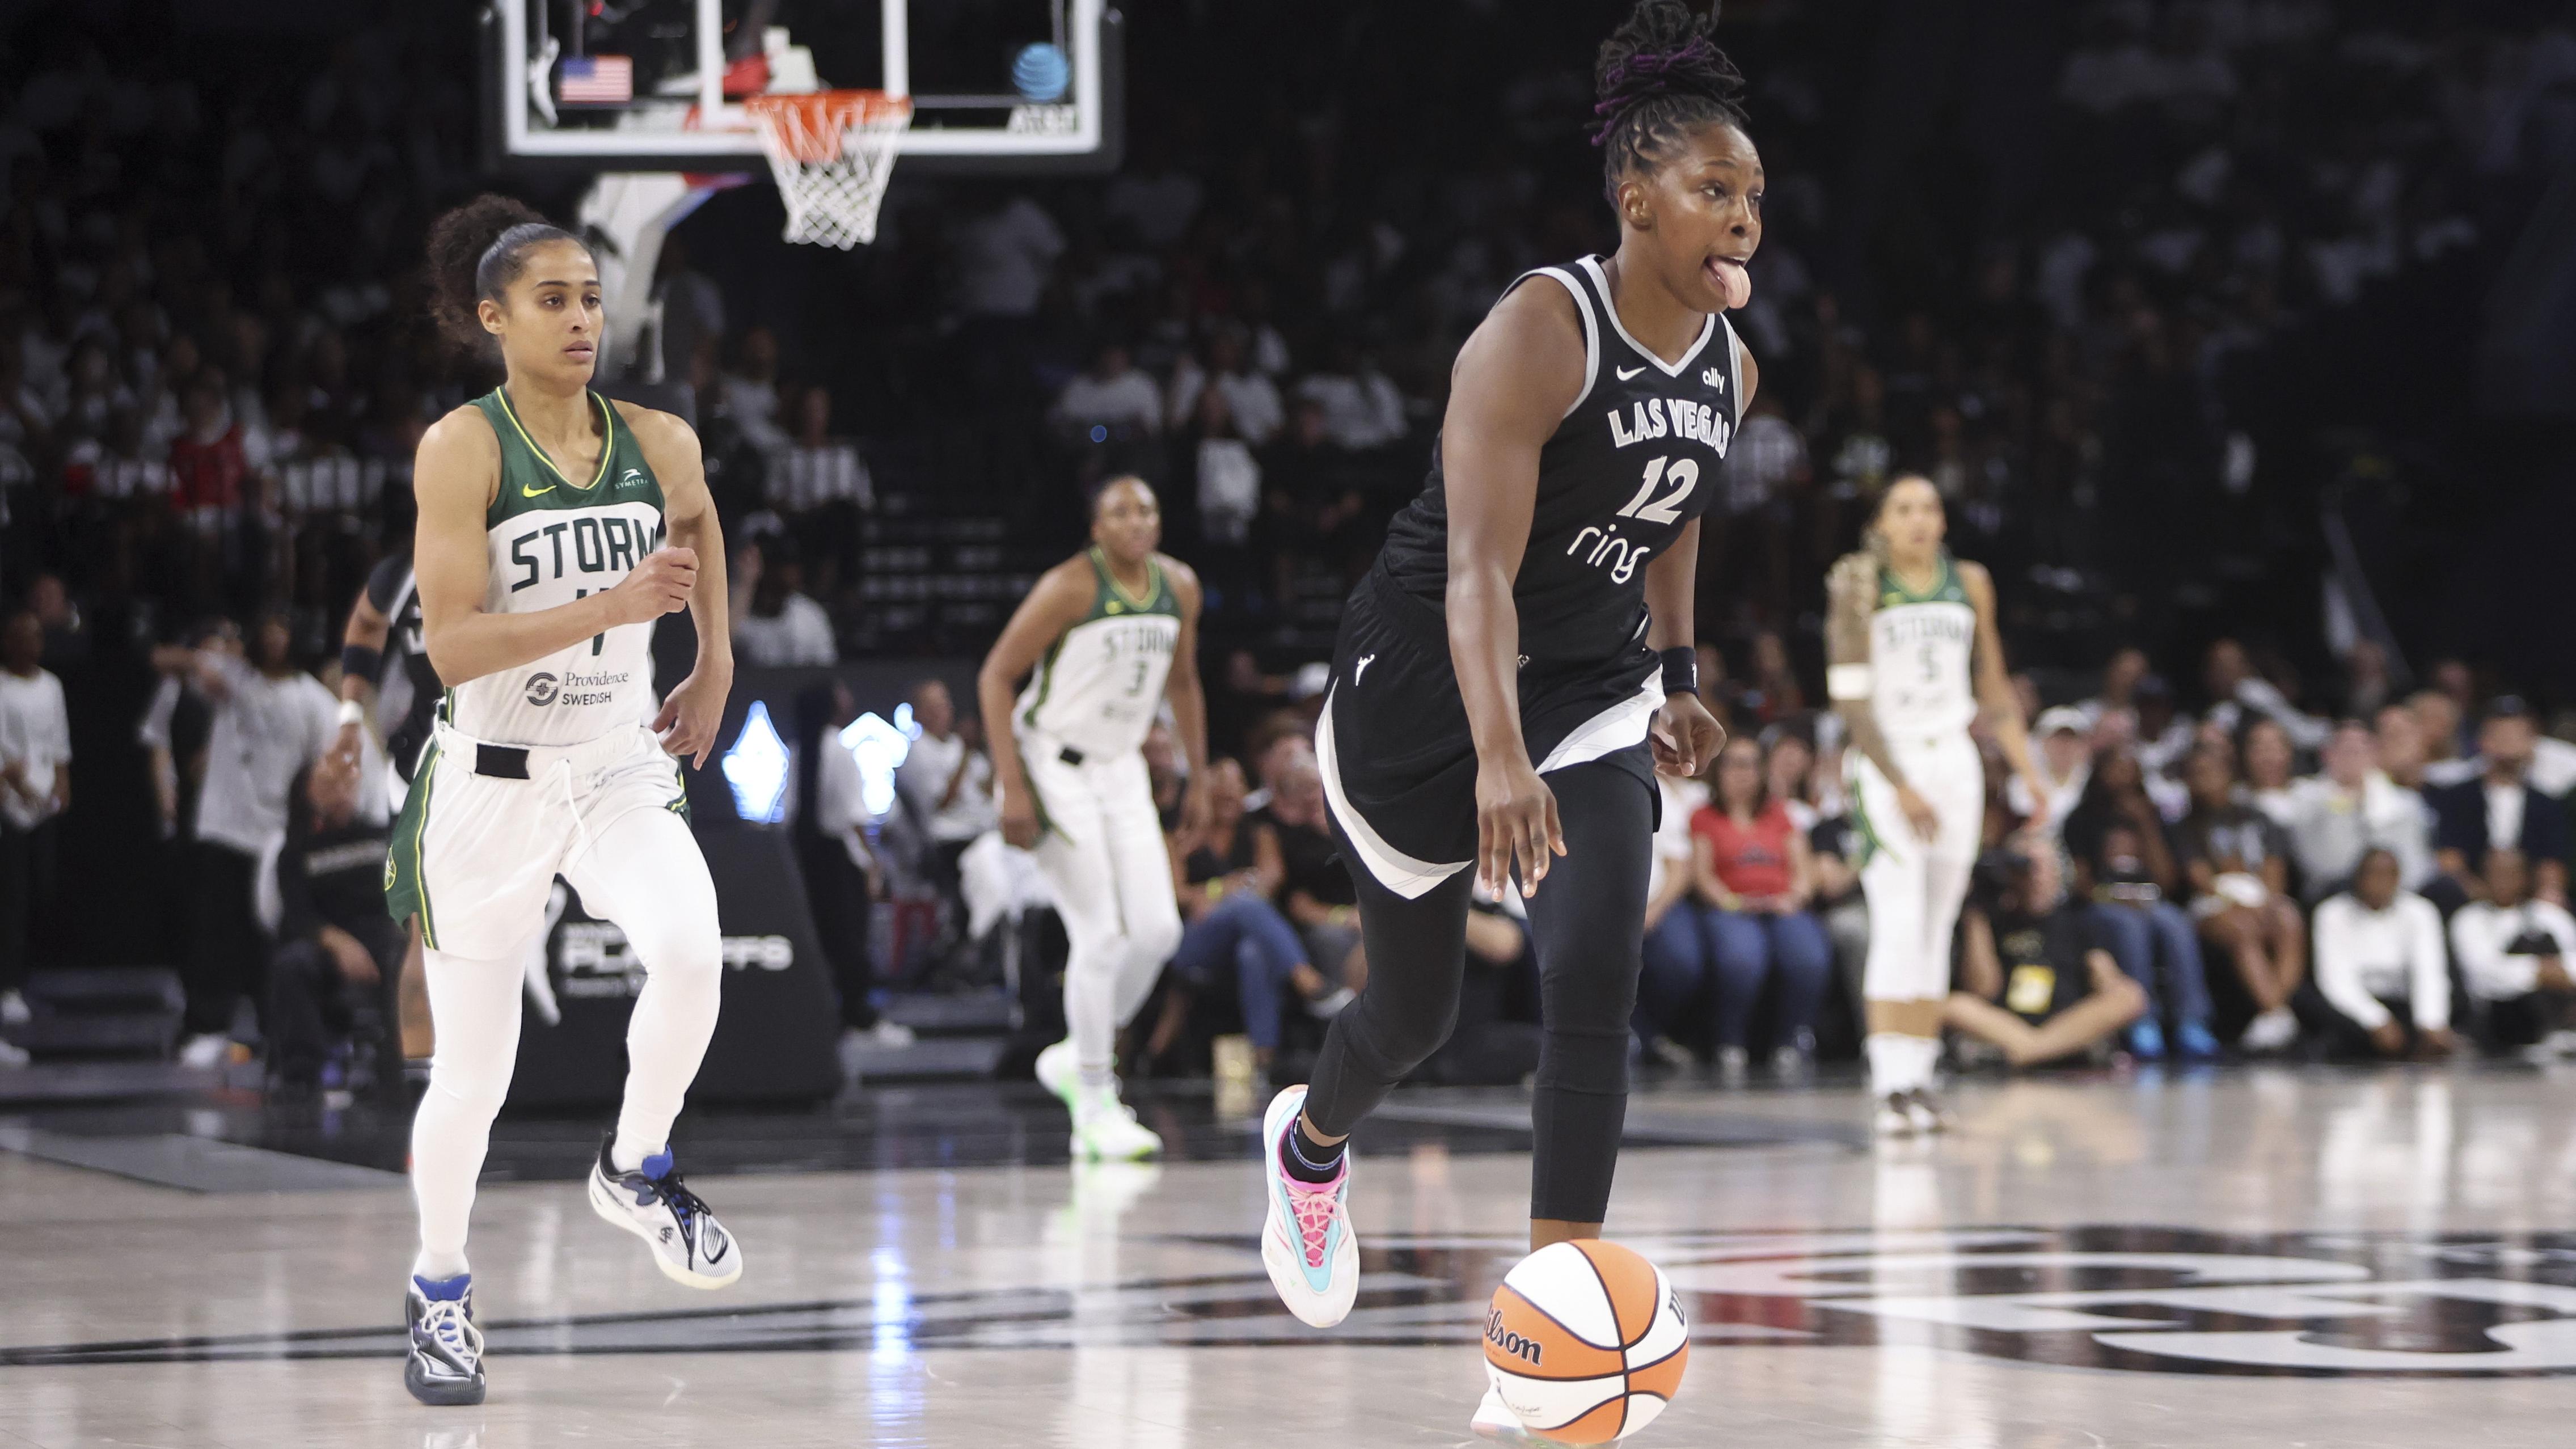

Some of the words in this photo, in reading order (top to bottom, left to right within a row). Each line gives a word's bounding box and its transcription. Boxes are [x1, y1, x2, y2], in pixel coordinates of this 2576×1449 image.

[1702, 367, 1725, 394] ally
[1607, 398, 1667, 449] LAS
[1666, 398, 1730, 460] VEGAS
[1616, 455, 1699, 525] 12
[1566, 523, 1650, 584] ring
[562, 691, 612, 706] SWEDISH
[564, 670, 628, 687] Providence
